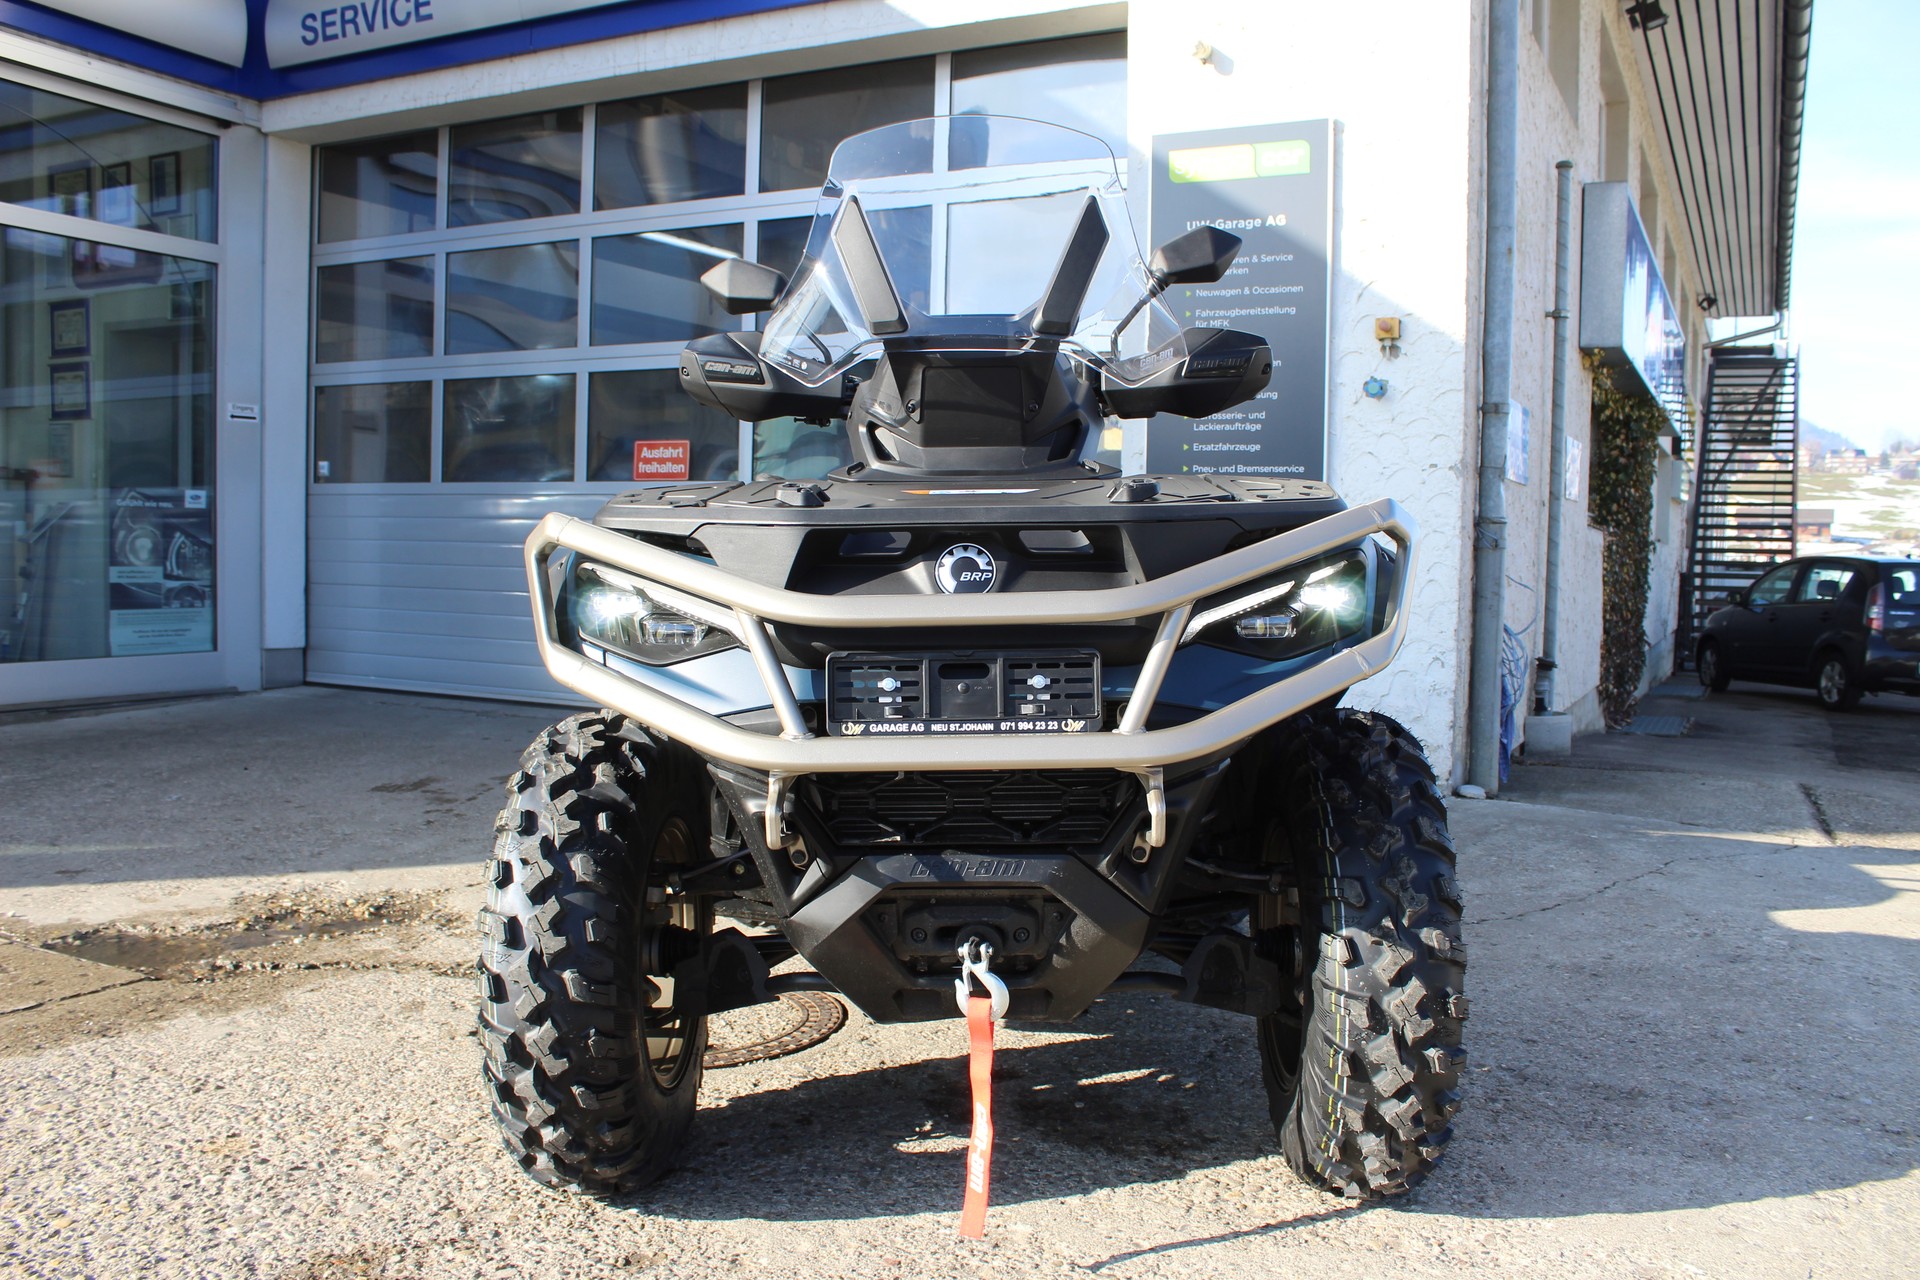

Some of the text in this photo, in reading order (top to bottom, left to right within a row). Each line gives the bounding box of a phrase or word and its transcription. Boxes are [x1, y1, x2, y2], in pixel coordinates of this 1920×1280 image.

[301, 0, 434, 46] SERVICE
[1265, 214, 1287, 226] AG
[1251, 255, 1259, 263] &
[1260, 253, 1294, 263] Service
[1224, 267, 1249, 276] arken
[1195, 285, 1304, 297] Neuwagen & Occasionen
[1195, 306, 1296, 318] Fahrzeugbereitstellung
[1195, 319, 1230, 328] für MFK
[1248, 411, 1266, 419] und
[1193, 422, 1262, 432] Lackieraufträge
[641, 447, 683, 458] Ausfahrt
[1193, 443, 1261, 452] Ersatzfahrzeuge
[639, 461, 685, 473] freihalten
[1192, 464, 1305, 473] Pneu- und Bremsenservice
[960, 571, 992, 581] BRP
[869, 723, 909, 732] GARAGE
[910, 723, 925, 732] AG
[931, 723, 948, 731] NEU
[949, 723, 994, 731] ST.JOHANN
[1000, 721, 1016, 730] 071
[1018, 721, 1033, 730] 994
[1035, 721, 1046, 730] 23
[1047, 721, 1058, 730] 23
